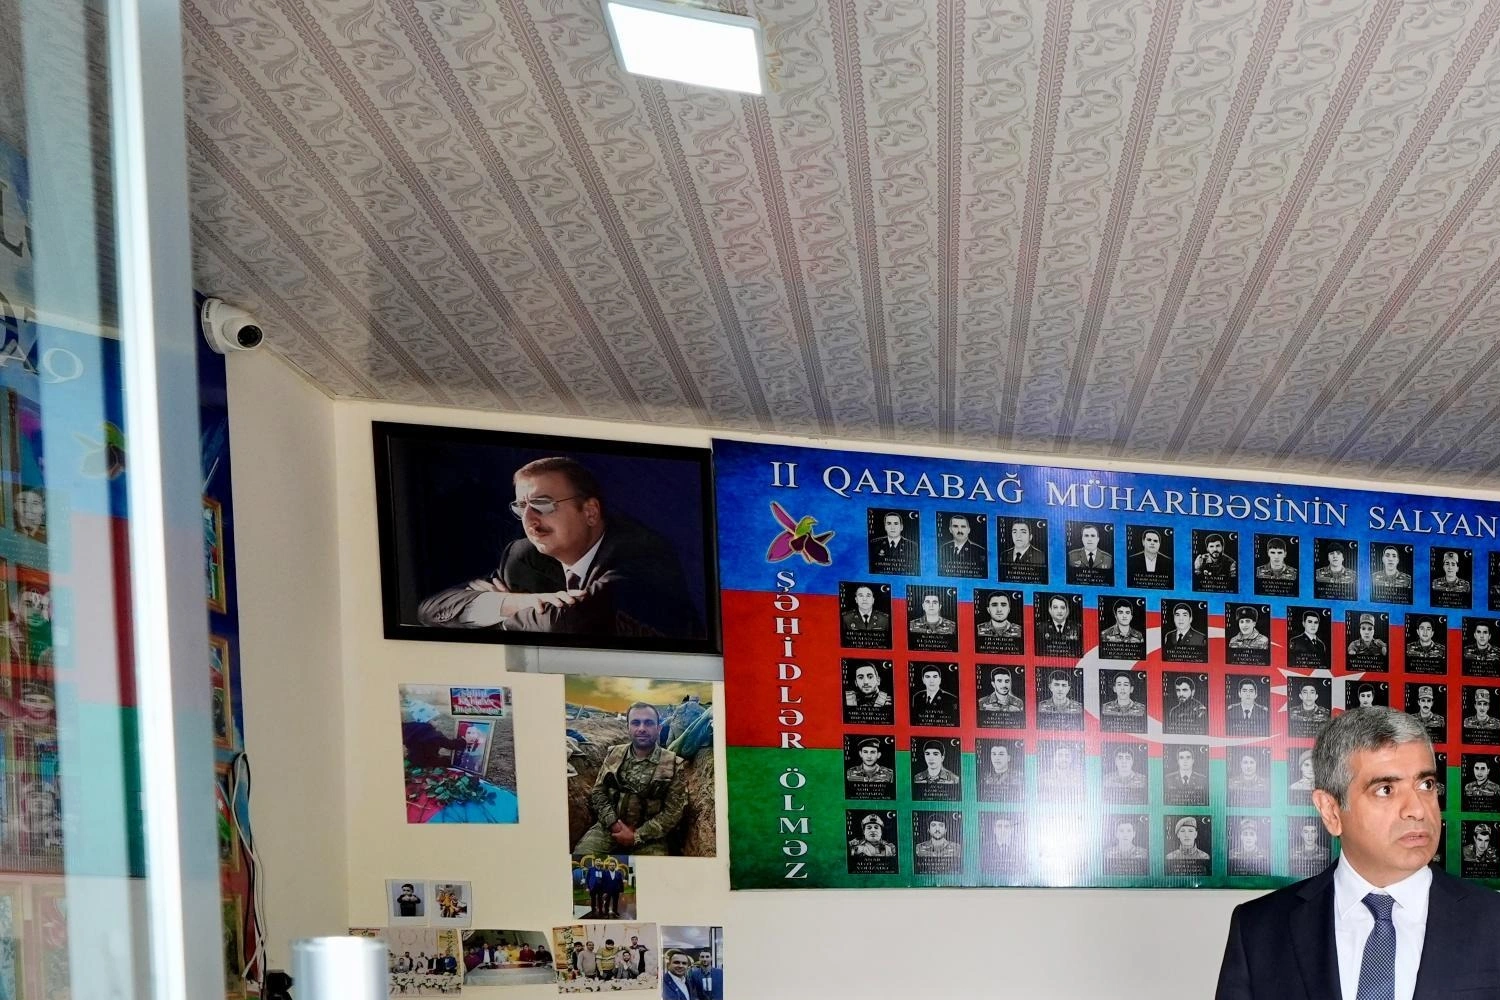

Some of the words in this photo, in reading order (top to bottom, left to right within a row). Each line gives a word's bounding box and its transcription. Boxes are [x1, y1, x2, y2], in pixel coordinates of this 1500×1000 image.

[770, 461, 799, 488] II
[822, 465, 1024, 504] QARABAĞ
[1046, 478, 1349, 527] MÜHARİBƏSİNİN
[1368, 506, 1498, 538] SALYAN
[779, 767, 811, 880] ÖLMƏZ
